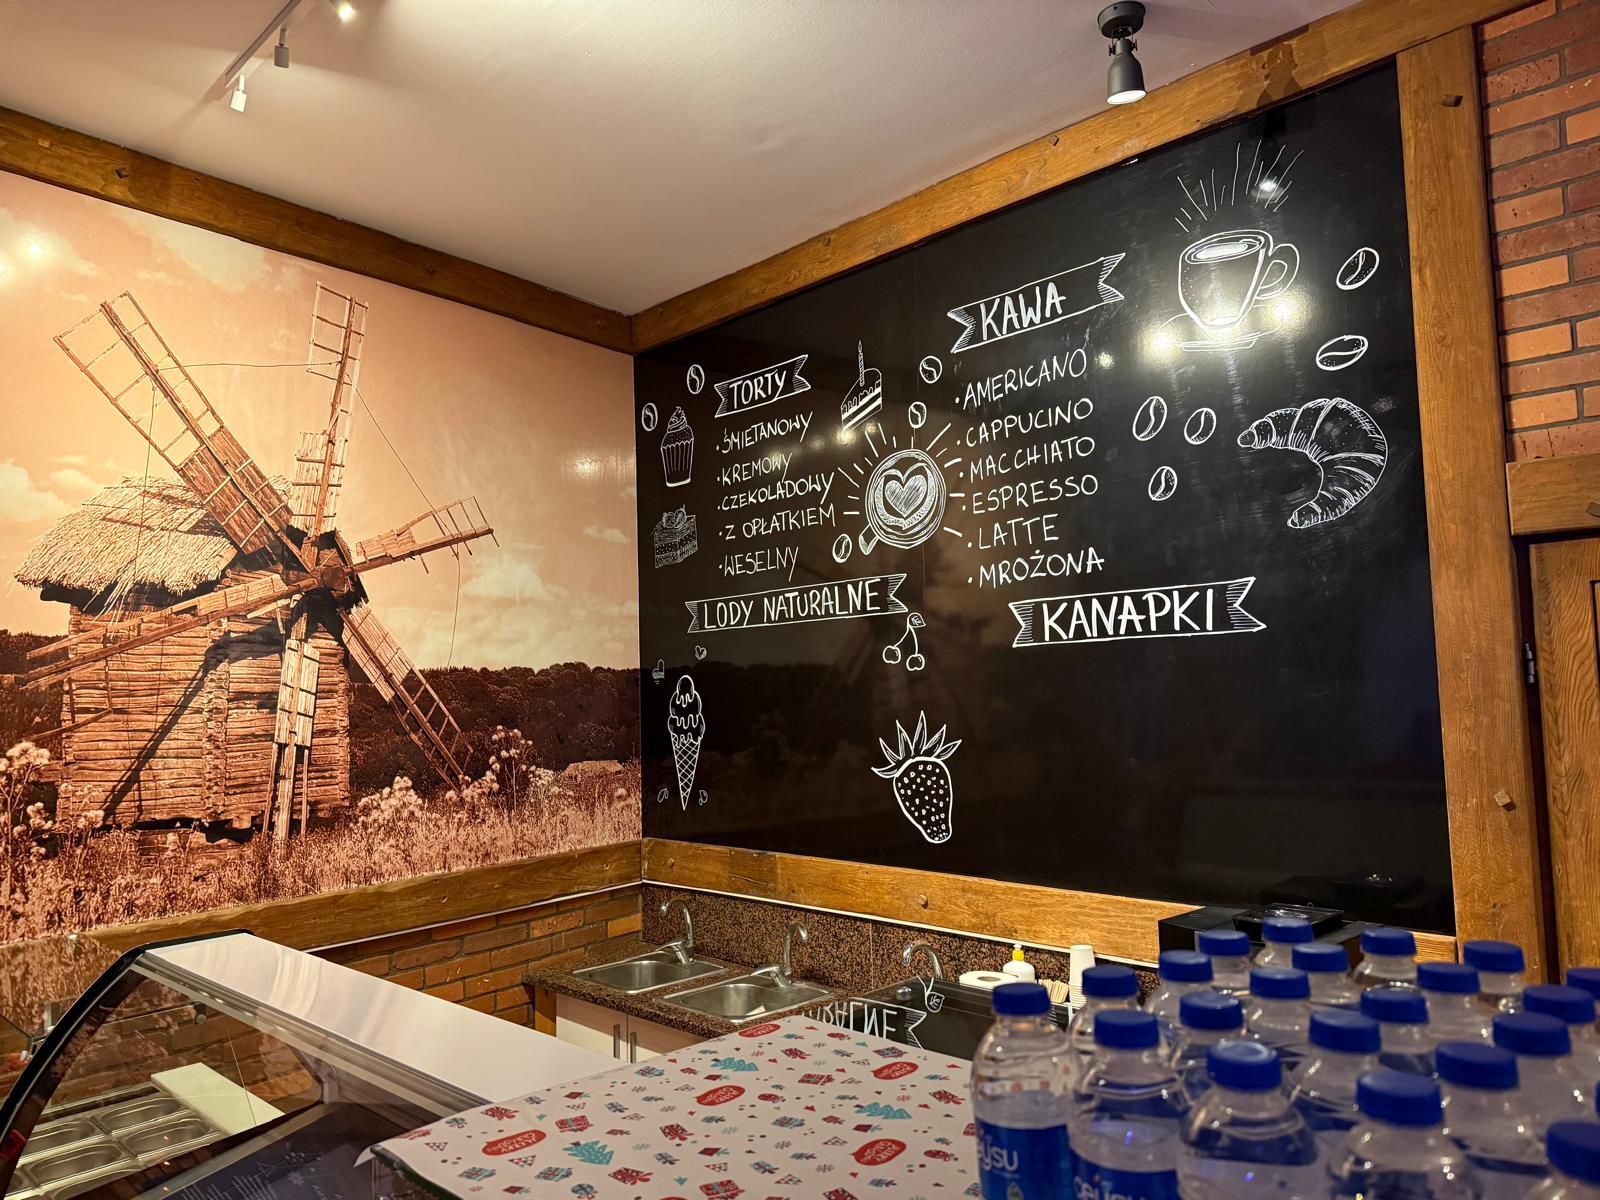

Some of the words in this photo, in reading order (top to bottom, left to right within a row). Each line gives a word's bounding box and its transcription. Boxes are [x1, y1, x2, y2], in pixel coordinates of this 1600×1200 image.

[979, 281, 1066, 340] KAWA
[728, 370, 787, 409] TORTY
[963, 348, 1088, 410] AMERICANO
[721, 411, 814, 454] ŚMIETANOWY
[966, 398, 1094, 448] CAPPUCINO
[722, 452, 793, 487] KREMOWY
[969, 436, 1096, 484] MACCHIATO
[721, 472, 835, 511] CZEKOLADOWY
[972, 474, 1099, 515] ESPRESSO
[725, 524, 736, 541] Z
[743, 503, 836, 538] OPŁATKIEM
[978, 513, 1059, 550] LATTE
[724, 546, 799, 582] WESELNY
[979, 547, 1105, 589] MROŻONA
[704, 600, 754, 630] LODY
[764, 579, 881, 623] NATURALNE
[1042, 588, 1214, 642] KANAPKI
